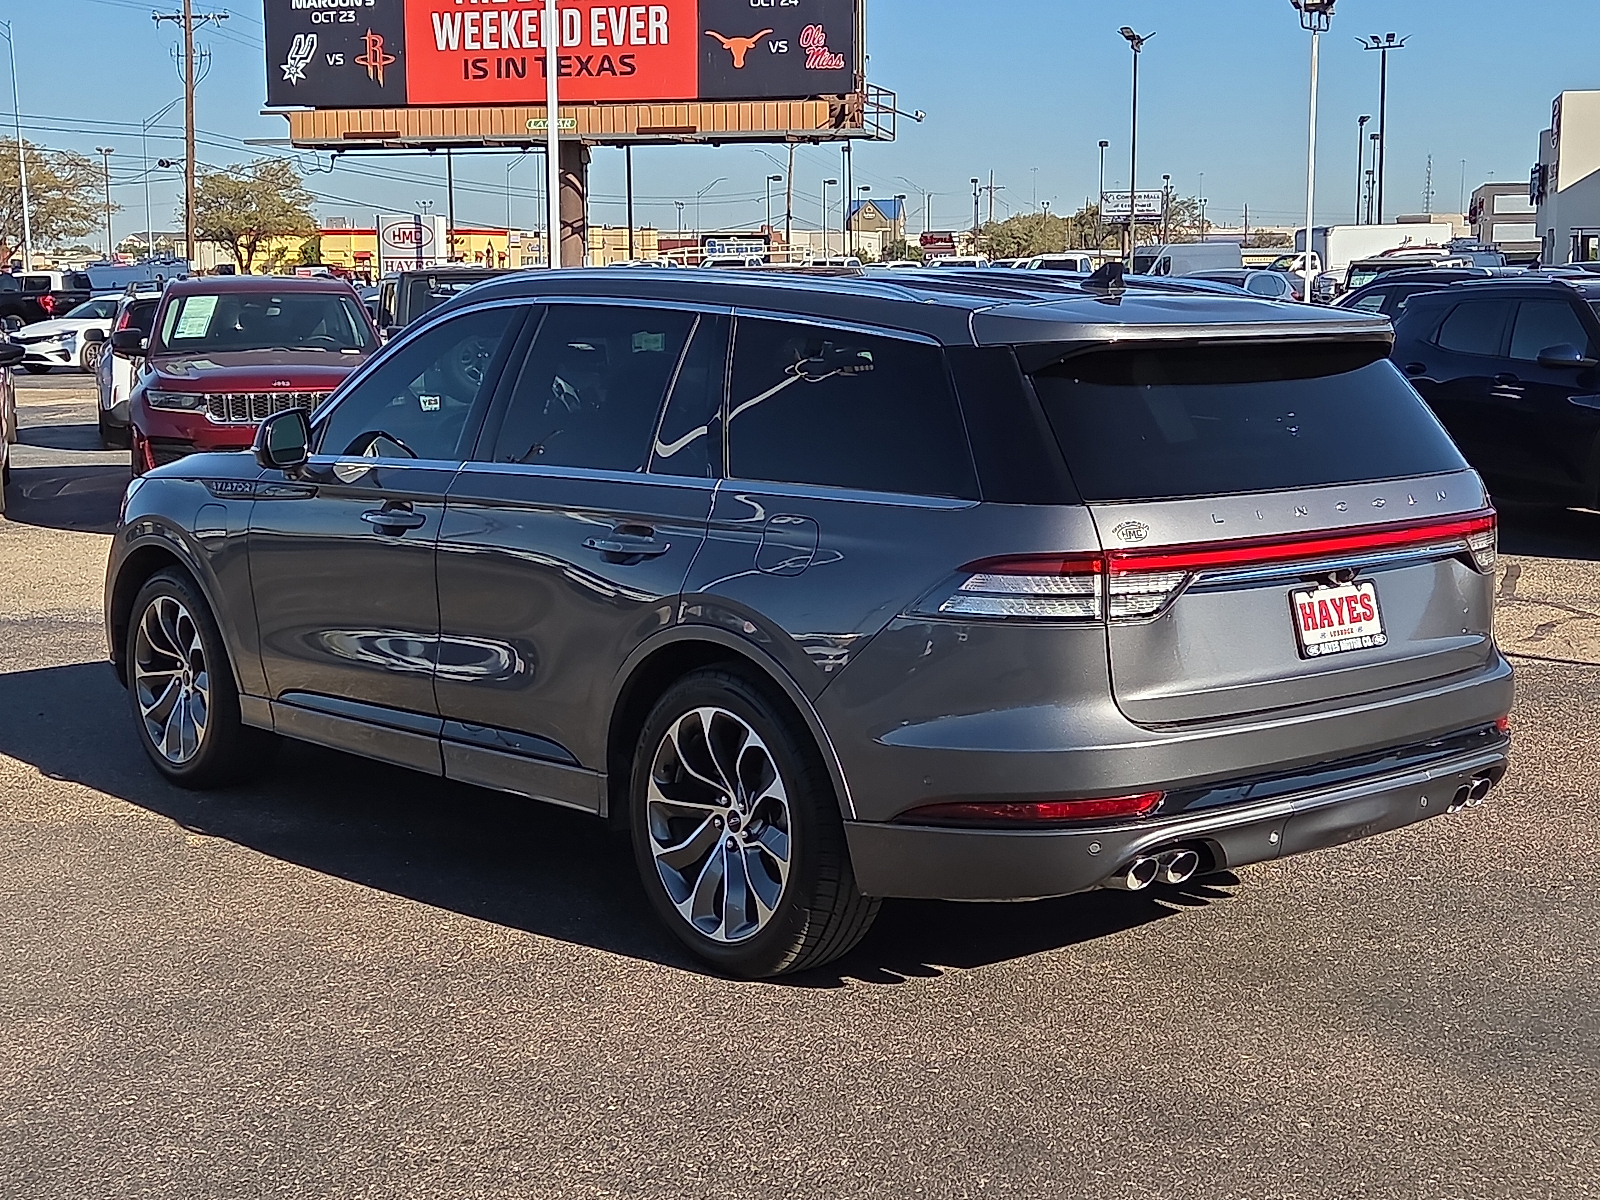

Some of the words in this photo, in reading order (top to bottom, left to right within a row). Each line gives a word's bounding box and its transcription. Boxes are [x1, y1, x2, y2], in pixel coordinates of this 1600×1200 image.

[311, 11, 336, 24] OCT
[338, 10, 356, 22] 23
[590, 5, 669, 46] EVER
[769, 40, 788, 53] VS
[800, 24, 826, 48] Ole
[326, 53, 344, 66] VS
[463, 58, 488, 80] IS
[496, 56, 527, 79] IN
[534, 53, 637, 78] TEXAS
[805, 46, 845, 69] Miss
[530, 119, 571, 129] LAAR
[1211, 491, 1447, 524] LINCOLN
[1121, 528, 1144, 540] HMC
[1299, 593, 1374, 631] HAYES
